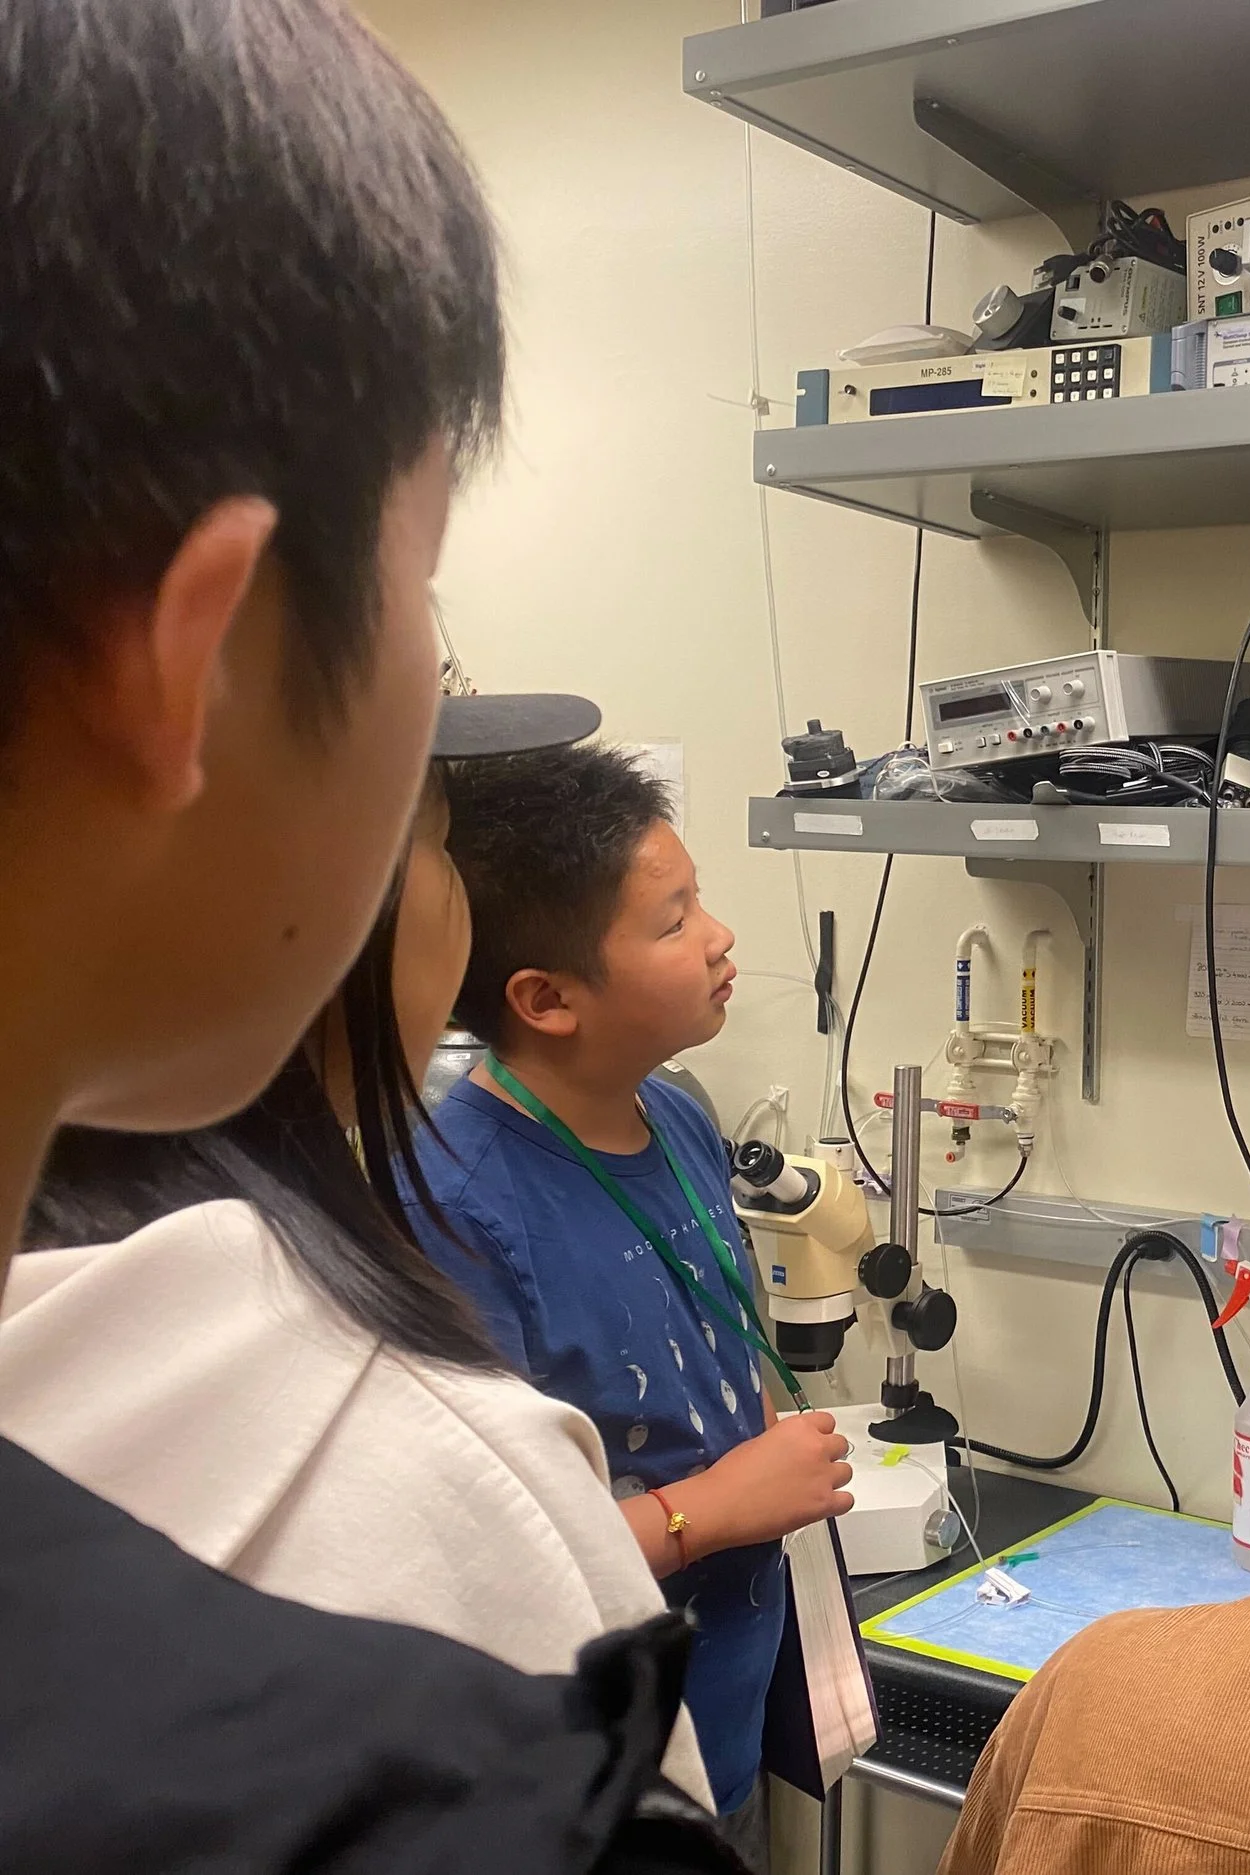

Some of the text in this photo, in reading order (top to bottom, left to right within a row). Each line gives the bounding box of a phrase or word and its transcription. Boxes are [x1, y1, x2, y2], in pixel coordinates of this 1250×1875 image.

[1197, 236, 1206, 267] 100W
[1122, 267, 1133, 316] OLYMPUS
[1197, 294, 1206, 315] SNT
[920, 366, 952, 378] MP-285
[670, 1204, 723, 1240] PHAES
